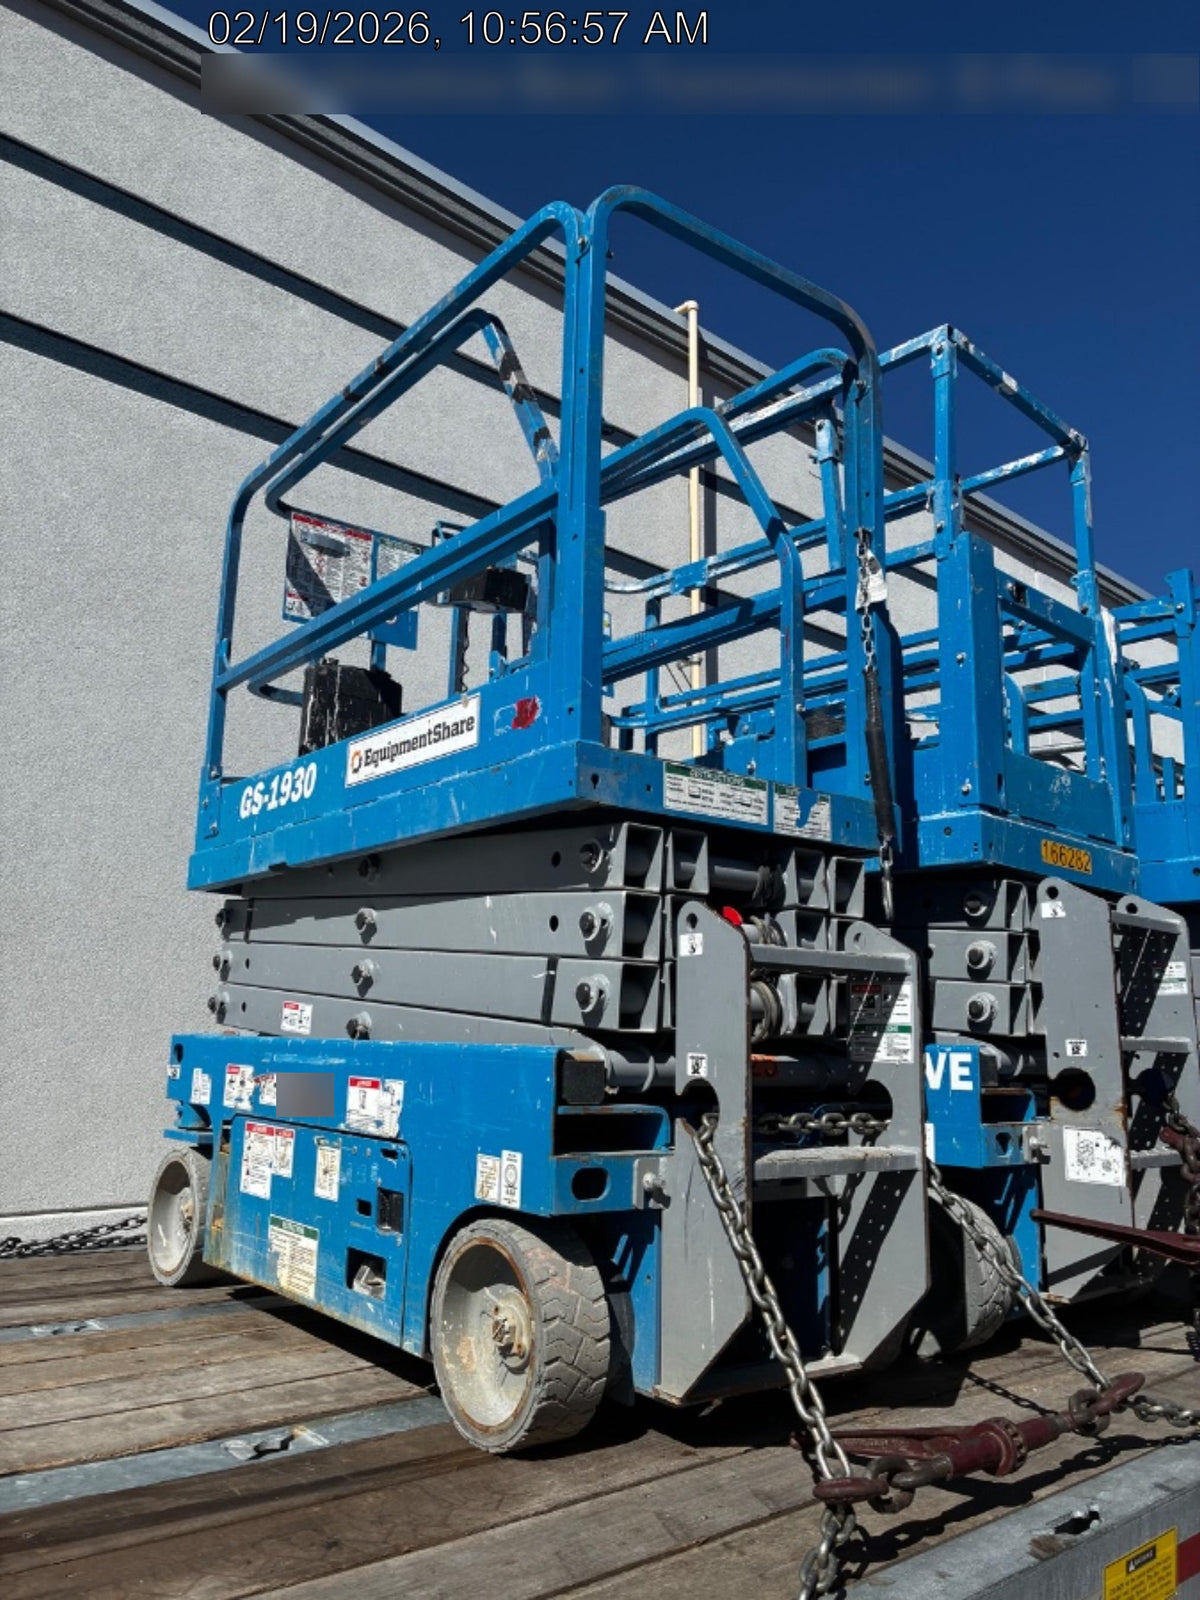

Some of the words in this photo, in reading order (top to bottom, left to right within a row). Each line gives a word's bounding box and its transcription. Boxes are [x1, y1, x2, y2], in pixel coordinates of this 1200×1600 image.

[363, 714, 475, 768] EquipmentShare
[239, 762, 317, 819] GS-1930
[1043, 840, 1091, 872] 166282
